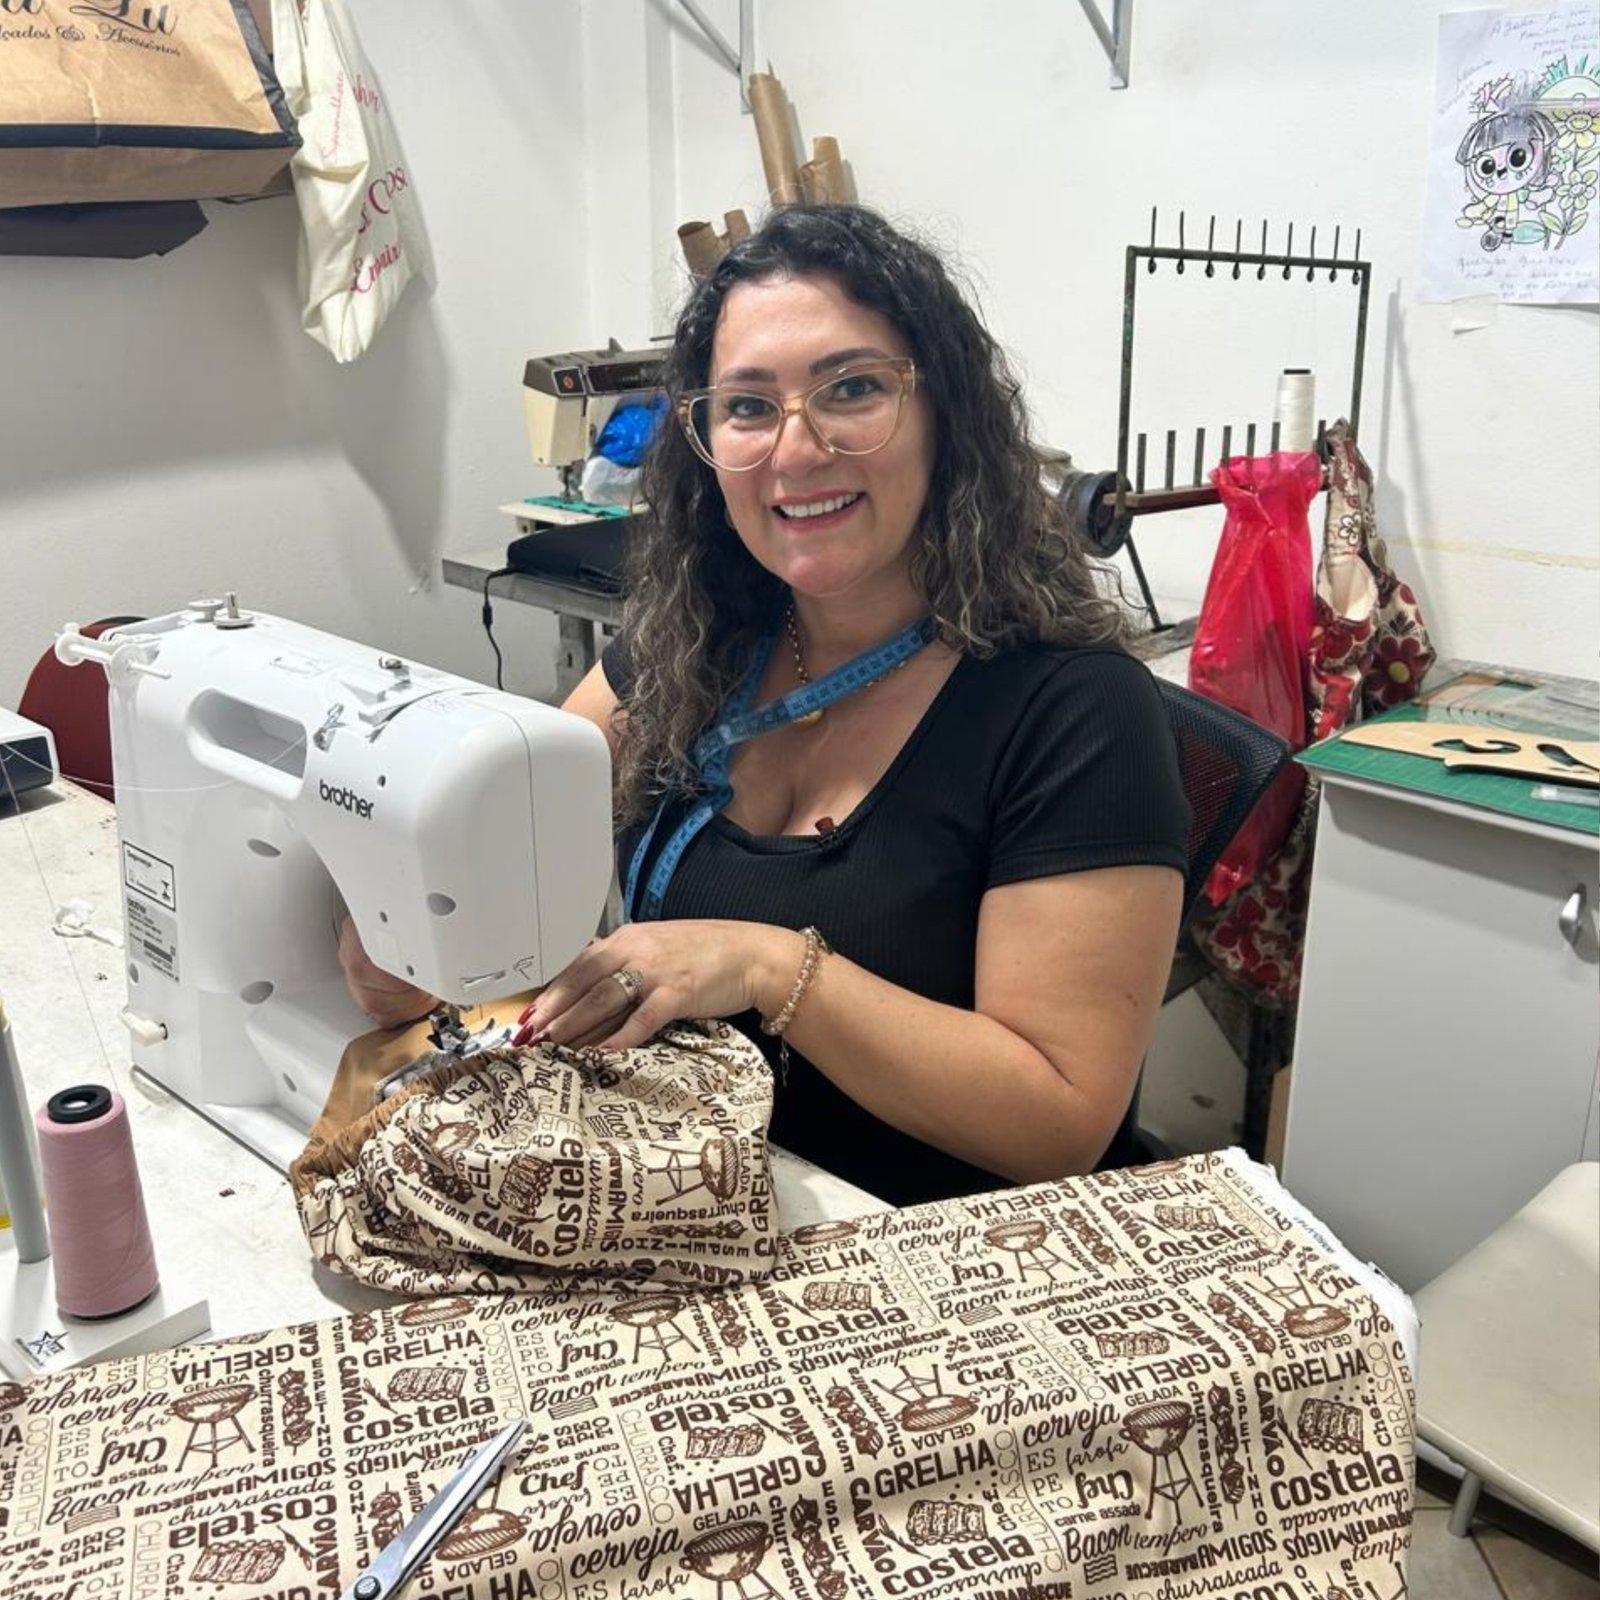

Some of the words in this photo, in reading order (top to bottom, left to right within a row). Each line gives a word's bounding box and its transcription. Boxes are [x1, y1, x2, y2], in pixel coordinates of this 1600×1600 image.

[319, 780, 374, 820] brother
[739, 1136, 751, 1195] GELADA
[553, 1138, 585, 1257] costela
[631, 1201, 747, 1222] churrasqueira
[966, 1188, 1062, 1219] GRELHA
[1119, 1179, 1210, 1206] GRELHA
[985, 1211, 1036, 1227] GELADA
[620, 1236, 750, 1258] ESPETINHO
[803, 1238, 857, 1256] GELADA
[898, 1225, 981, 1253] cerveja
[1040, 1207, 1104, 1280] churrasqueira
[771, 1247, 877, 1282] GRELHA
[930, 1288, 967, 1301] carne
[969, 1277, 1015, 1293] assada
[936, 1285, 1013, 1320] Bacon
[1016, 1277, 1088, 1296] tempero
[1047, 1287, 1166, 1320] churrascada
[1083, 1274, 1159, 1300] AMIGOS
[404, 1319, 467, 1337] GELADA
[511, 1302, 609, 1332] cerveja
[554, 1322, 614, 1347] farofa
[776, 1306, 909, 1347] costela
[1219, 1273, 1297, 1359] churrasqueira
[363, 1330, 483, 1368] GRELHA
[557, 1338, 618, 1372] Chef
[785, 1323, 916, 1360] churrascada
[789, 1346, 873, 1375] AMIGOS
[858, 1344, 940, 1370] tempero
[872, 1328, 953, 1358] BARBECUE
[1300, 1334, 1353, 1354] GELADA
[171, 1344, 294, 1386] GRELHA
[183, 1373, 250, 1394] GELADA
[527, 1373, 570, 1389] carne
[574, 1358, 626, 1379] assada
[620, 1361, 706, 1387] tempero
[695, 1357, 782, 1387] AMIGOS
[956, 1360, 1017, 1386] Chef
[1101, 1354, 1211, 1394] GRELHA
[1272, 1349, 1370, 1392] GRELHA
[28, 1377, 137, 1415] cerveja
[312, 1358, 333, 1458] ESPETINHO
[338, 1355, 367, 1423] CARVÃO
[530, 1373, 616, 1412] Bacon
[644, 1374, 786, 1412] churrascada
[982, 1387, 1078, 1425] cerveja
[1124, 1386, 1183, 1407] GELADA
[60, 1392, 171, 1430] cerveja
[101, 1414, 171, 1443] farofa
[259, 1369, 276, 1468] churrasqueira
[343, 1397, 496, 1444] costela
[847, 1366, 907, 1458] churrasqueira
[1023, 1403, 1120, 1449] cerveja
[1254, 1371, 1285, 1477] CARVÃO
[349, 1415, 498, 1461] churrascada
[574, 1442, 620, 1460] carne
[911, 1422, 975, 1450] GELADA
[1066, 1436, 1129, 1474] farofa
[1230, 1371, 1268, 1526] ESPETINHO
[92, 1437, 167, 1477] Chef
[237, 1458, 337, 1494] AMIGOS
[344, 1442, 442, 1479] AMIGOS
[513, 1454, 570, 1476] assada
[621, 1408, 674, 1524] CHURRASCO
[874, 1438, 996, 1499] GRELHA
[1186, 1381, 1224, 1533] churrasqueira
[13, 1417, 50, 1538] CHURRASCO
[53, 1479, 103, 1499] carne
[108, 1463, 168, 1485] assada
[153, 1462, 256, 1497] tempero
[520, 1461, 589, 1496] Chef
[672, 1456, 802, 1515] GRELHA
[1074, 1469, 1133, 1509] Chef
[1270, 1451, 1404, 1511] costela
[45, 1481, 151, 1526] Bacon
[169, 1479, 335, 1526] churrascada
[693, 1502, 762, 1532] GELADA
[1054, 1510, 1097, 1527] carne
[1098, 1502, 1141, 1520] assada
[1279, 1487, 1409, 1534] churrascada
[528, 1502, 642, 1553] cerveja
[850, 1477, 896, 1574] CARVÃO
[1063, 1523, 1132, 1565] Bacon
[1133, 1523, 1210, 1556] tempero
[1282, 1519, 1368, 1561] AMIGOS
[443, 1550, 518, 1581] GELADA
[570, 1526, 684, 1582] cerveja
[881, 1533, 1035, 1596] costela
[1125, 1552, 1201, 1581] BARBECUE
[1196, 1528, 1277, 1568] AMIGOS
[72, 1557, 124, 1578] carne
[1156, 1555, 1283, 1600] churrascada
